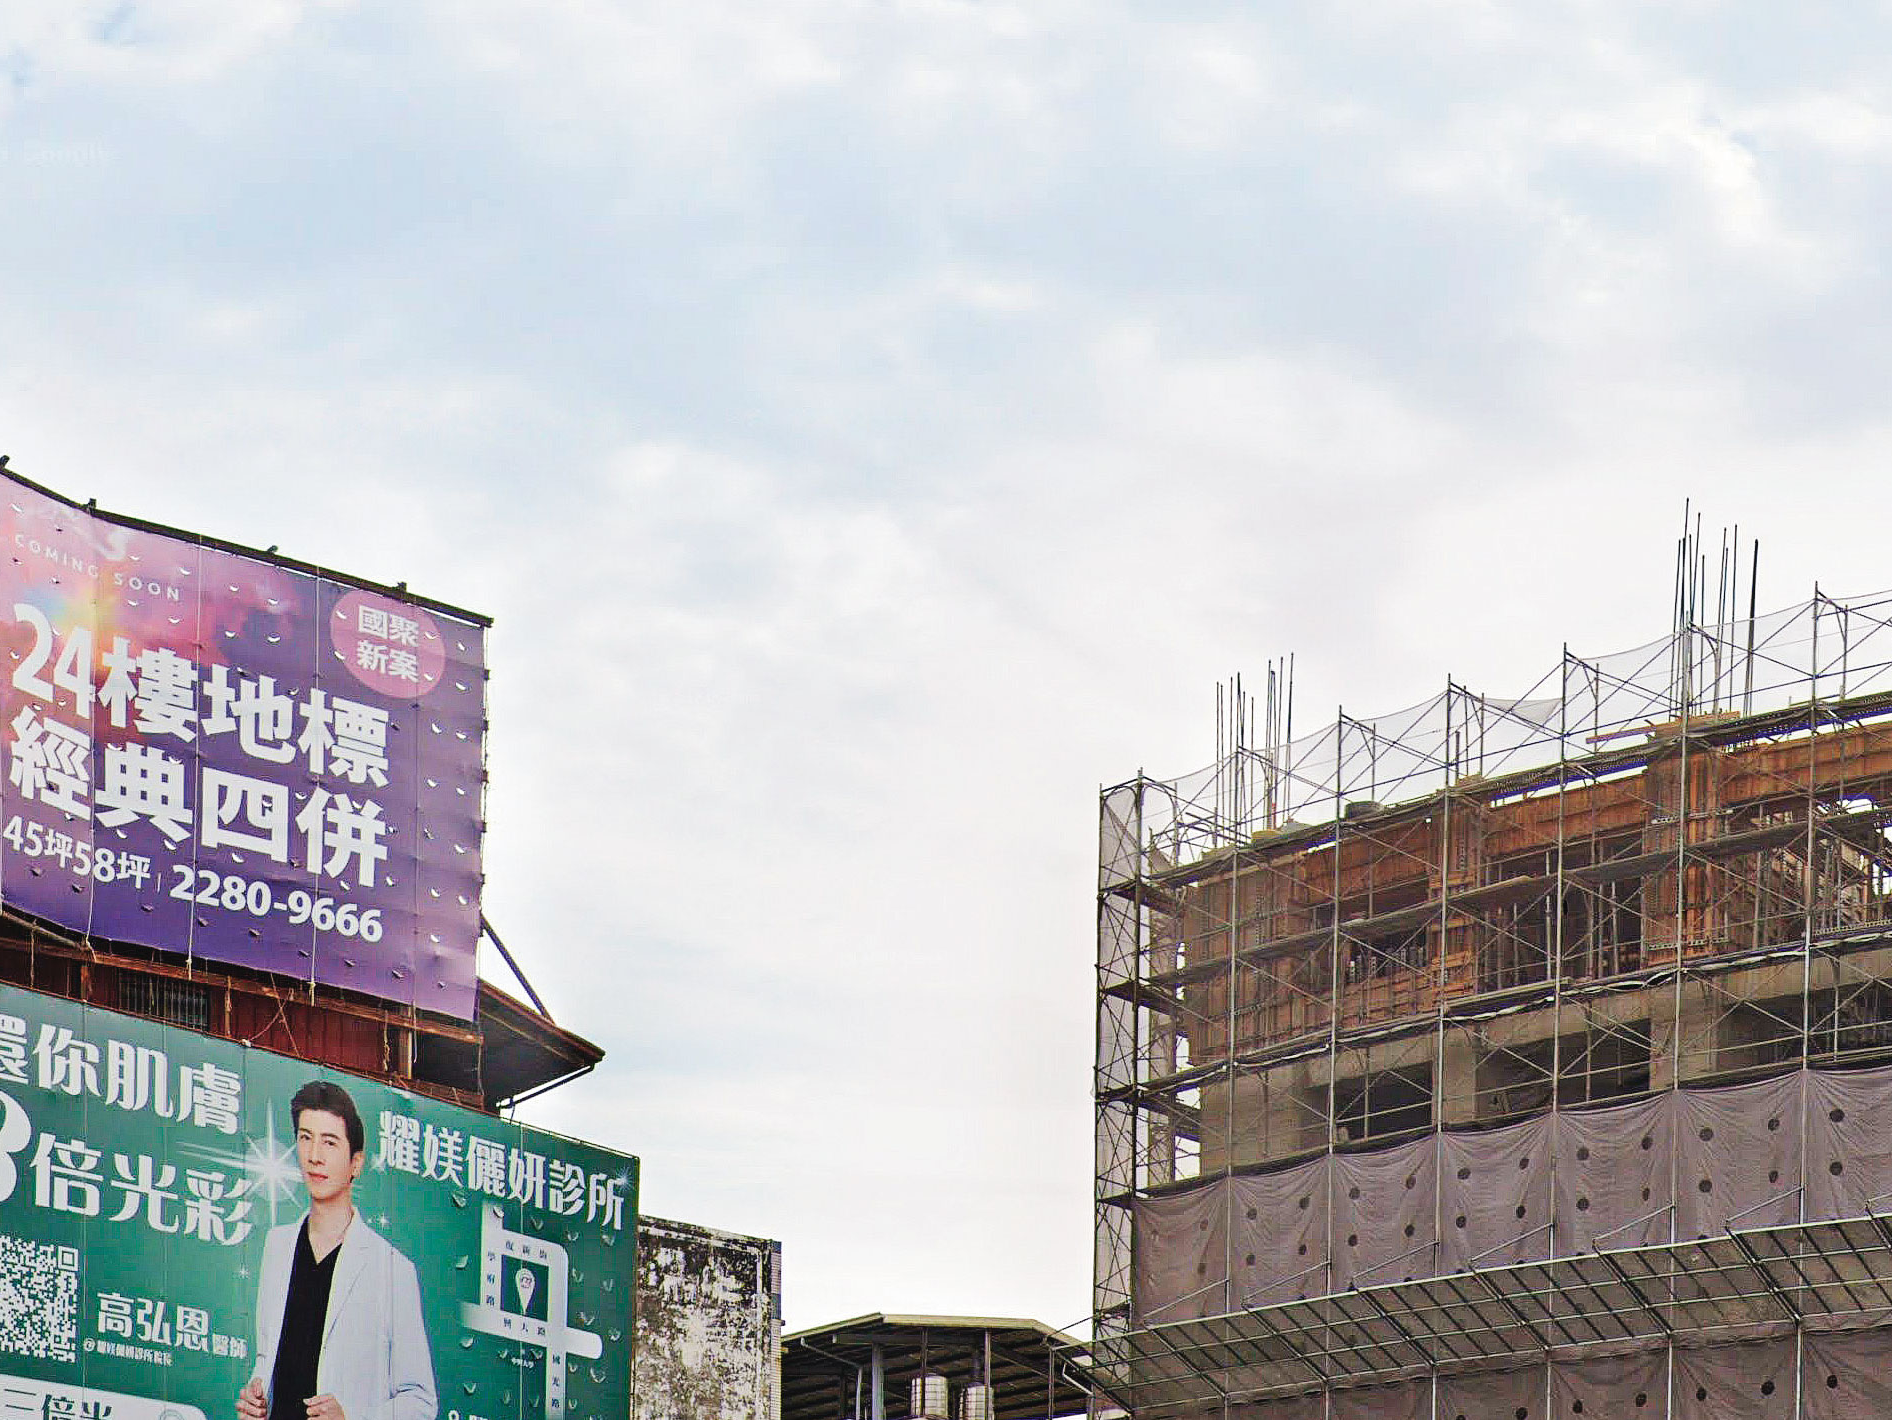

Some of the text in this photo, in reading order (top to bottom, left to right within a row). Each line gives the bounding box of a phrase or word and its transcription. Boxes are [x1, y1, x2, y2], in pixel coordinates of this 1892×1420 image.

[114, 573, 180, 602] SOON
[358, 605, 419, 644] 國聚
[356, 640, 418, 683] 新案
[12, 602, 390, 788] 24樓地標
[9, 706, 390, 888] 經典四併
[3, 815, 383, 943] 45坪58坪 2280-9666
[96, 1292, 209, 1352] 高弘恩
